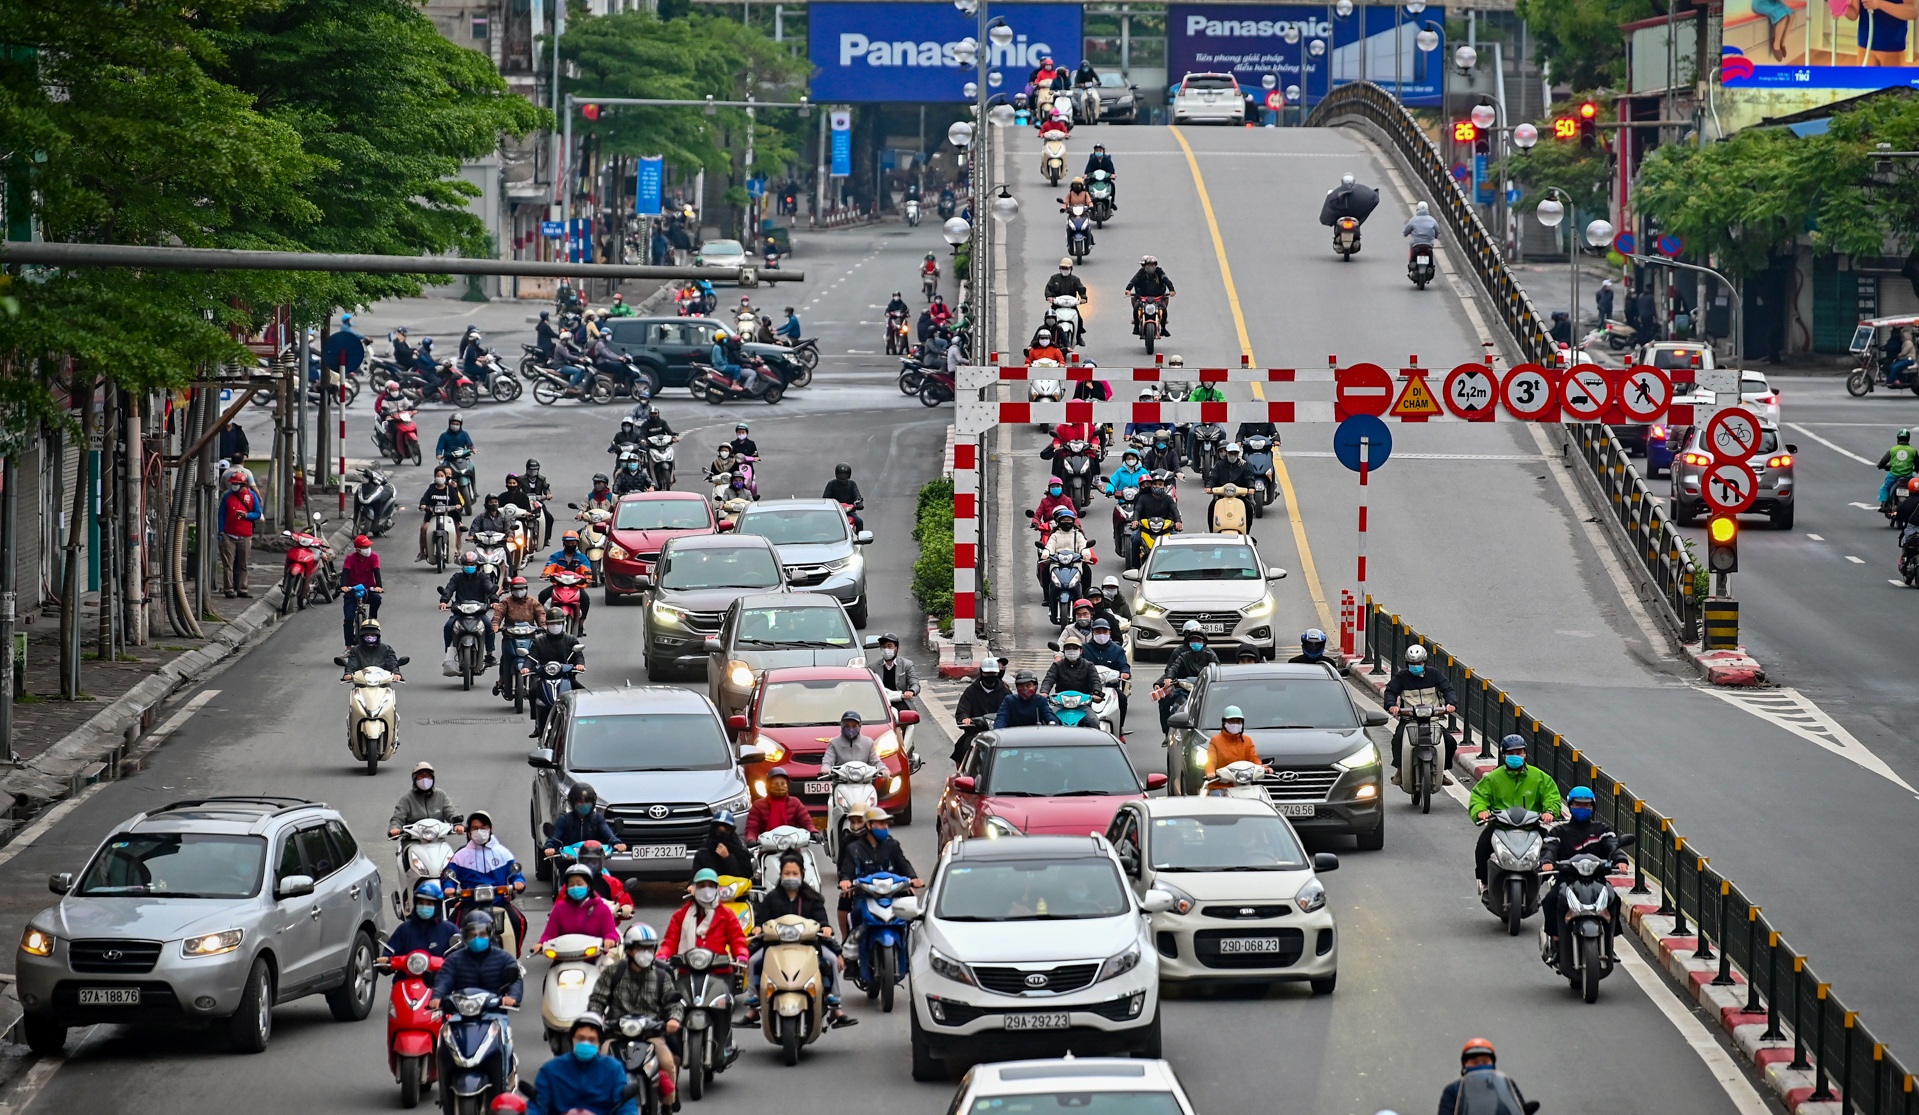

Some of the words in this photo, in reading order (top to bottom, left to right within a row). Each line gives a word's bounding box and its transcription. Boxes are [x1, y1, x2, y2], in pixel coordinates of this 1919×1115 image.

[1186, 15, 1329, 37] Panasonic
[1214, 54, 1241, 63] phong
[1302, 63, 1316, 72] hí
[1454, 123, 1475, 141] 26
[1555, 119, 1576, 138] 50
[1412, 387, 1422, 397] ĐI
[1516, 379, 1540, 404] 3t
[1403, 397, 1429, 410] CHẬM
[806, 783, 833, 793] 15D-0
[633, 846, 685, 858] 30F-232.17
[1222, 939, 1278, 952] 29D-068.23
[80, 990, 138, 1003] 37A-188.76
[1006, 1014, 1068, 1028] 29A-292.23
